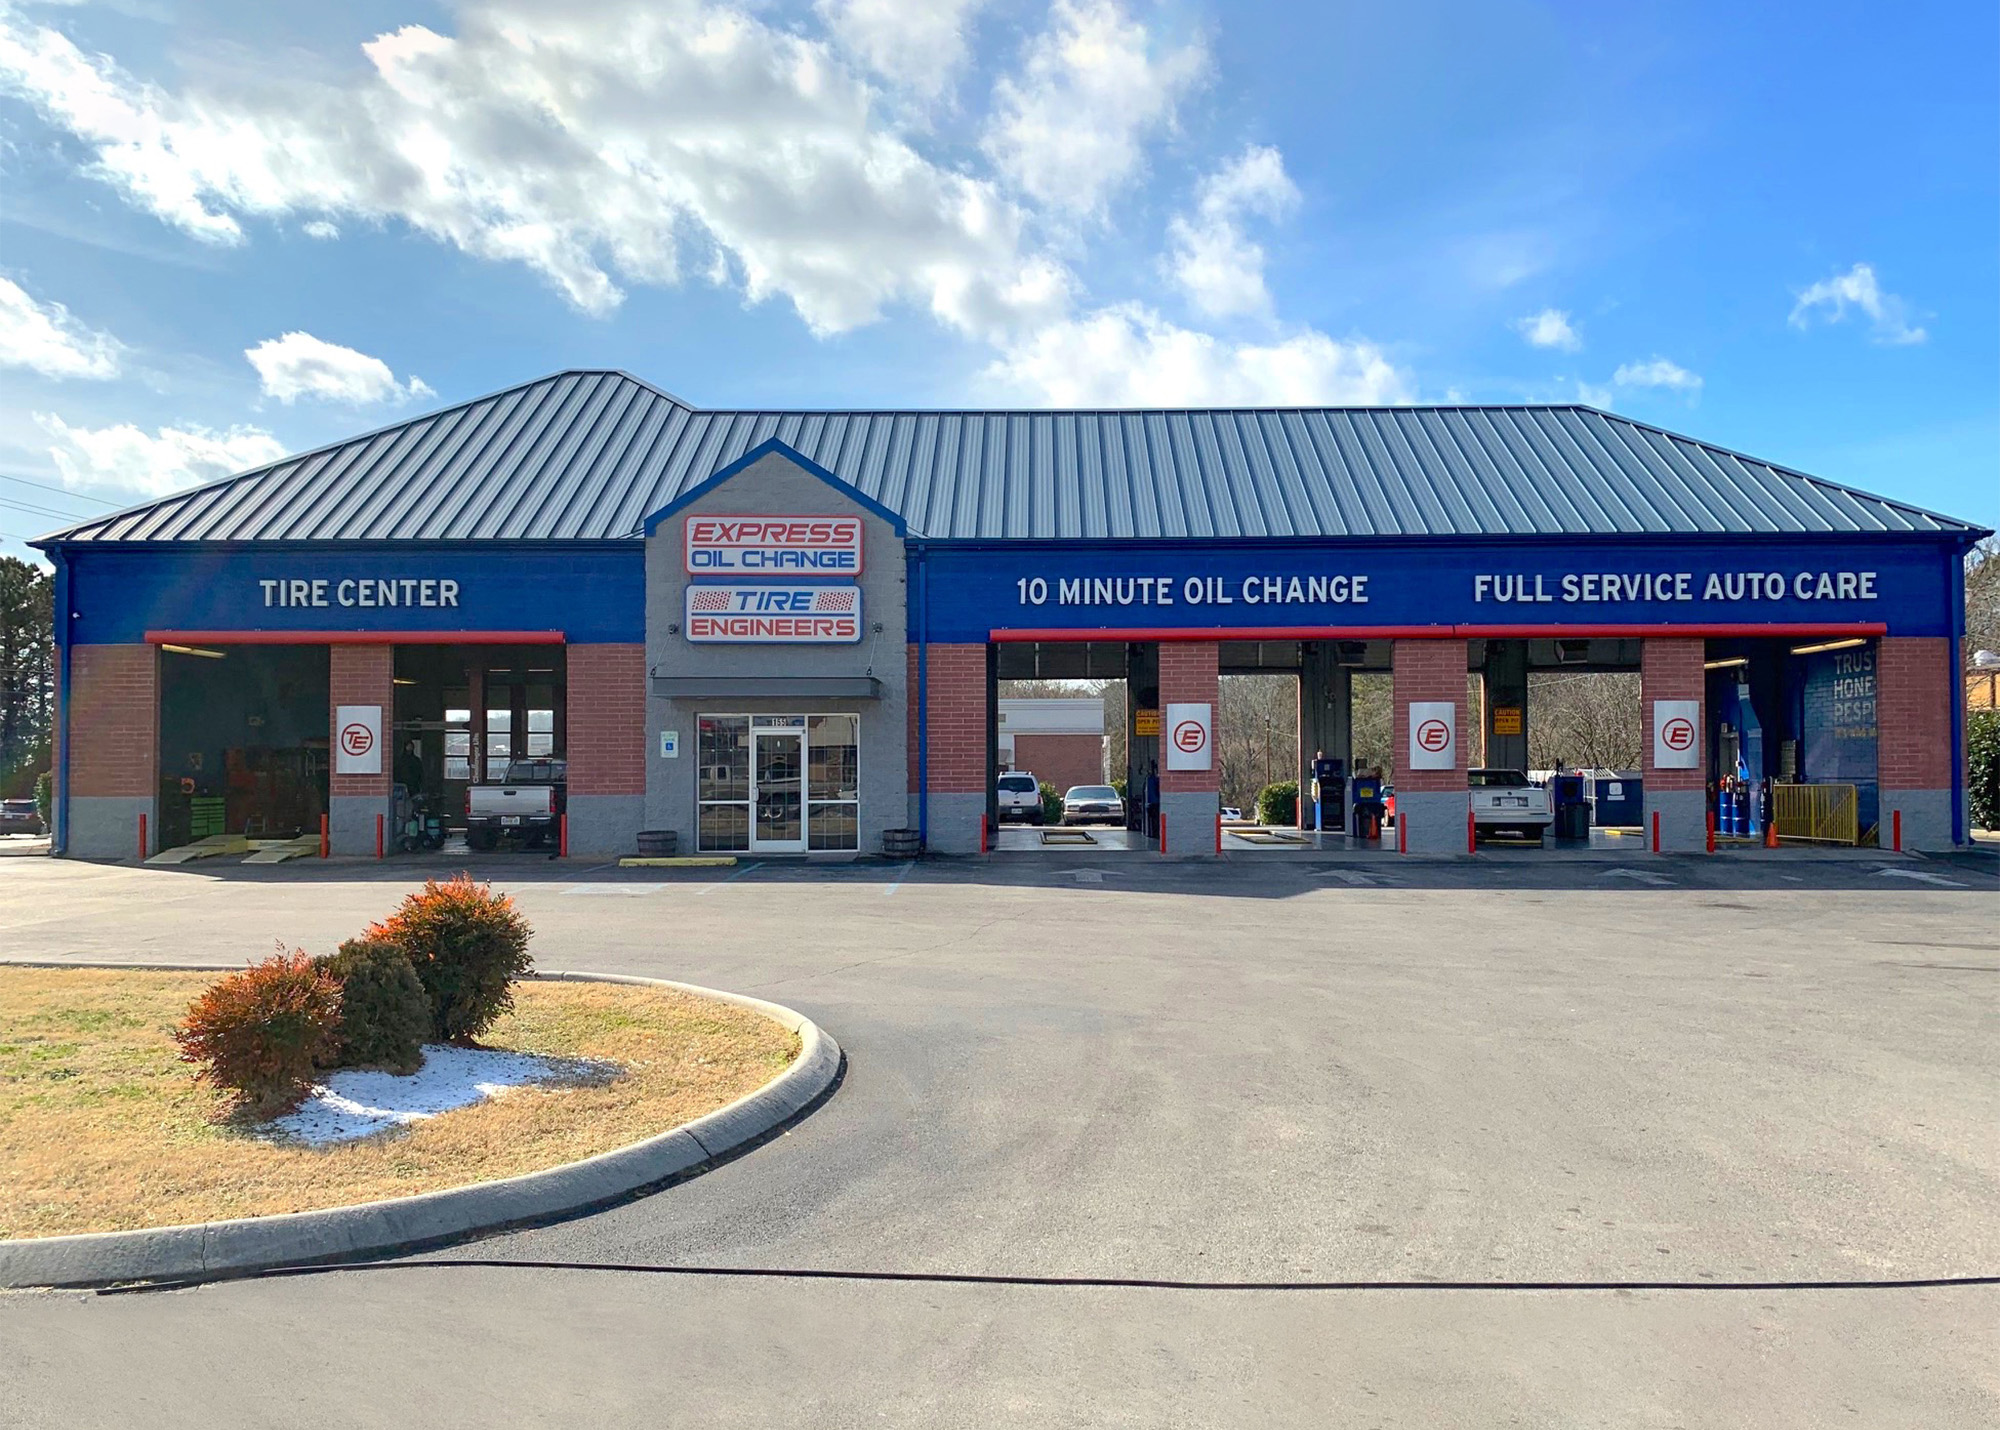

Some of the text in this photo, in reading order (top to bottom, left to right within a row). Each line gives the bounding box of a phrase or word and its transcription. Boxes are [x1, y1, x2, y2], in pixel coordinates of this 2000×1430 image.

[691, 522, 857, 543] EXPRESS
[691, 550, 856, 568] OIL CHANGE
[259, 579, 459, 607] TIRE CENTER
[1017, 575, 1369, 605] 10 MINUTE OIL CHANGE
[1475, 571, 1878, 602] FULL SERVICE AUTO CARE
[735, 591, 814, 611] TIRE
[691, 618, 856, 636] ENGINEERS
[1834, 651, 1875, 674] TRUS
[1834, 676, 1876, 699] HONE
[346, 731, 369, 749] TE
